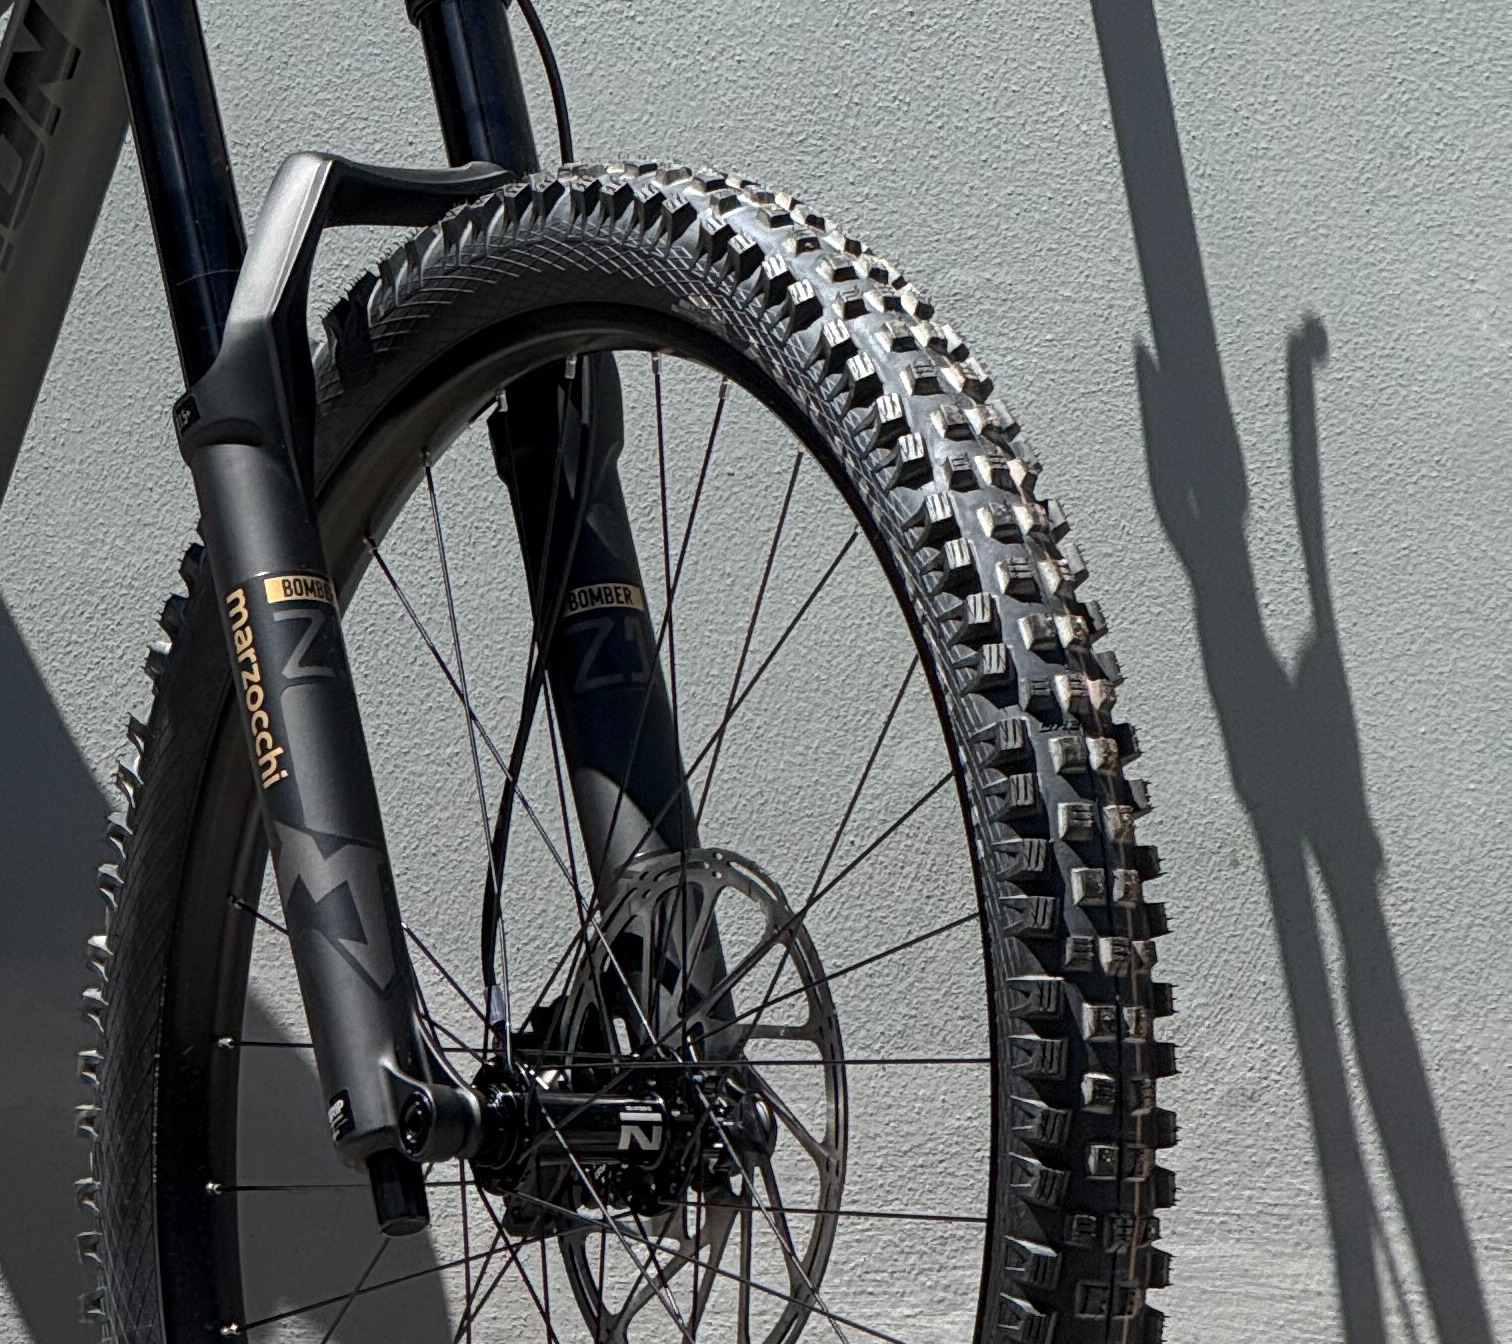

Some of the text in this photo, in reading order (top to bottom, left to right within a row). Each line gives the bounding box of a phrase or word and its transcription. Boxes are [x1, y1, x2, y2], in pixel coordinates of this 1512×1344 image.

[281, 577, 332, 600] BOMBE
[568, 585, 636, 612] BOMBER
[226, 588, 289, 791] marzocchi
